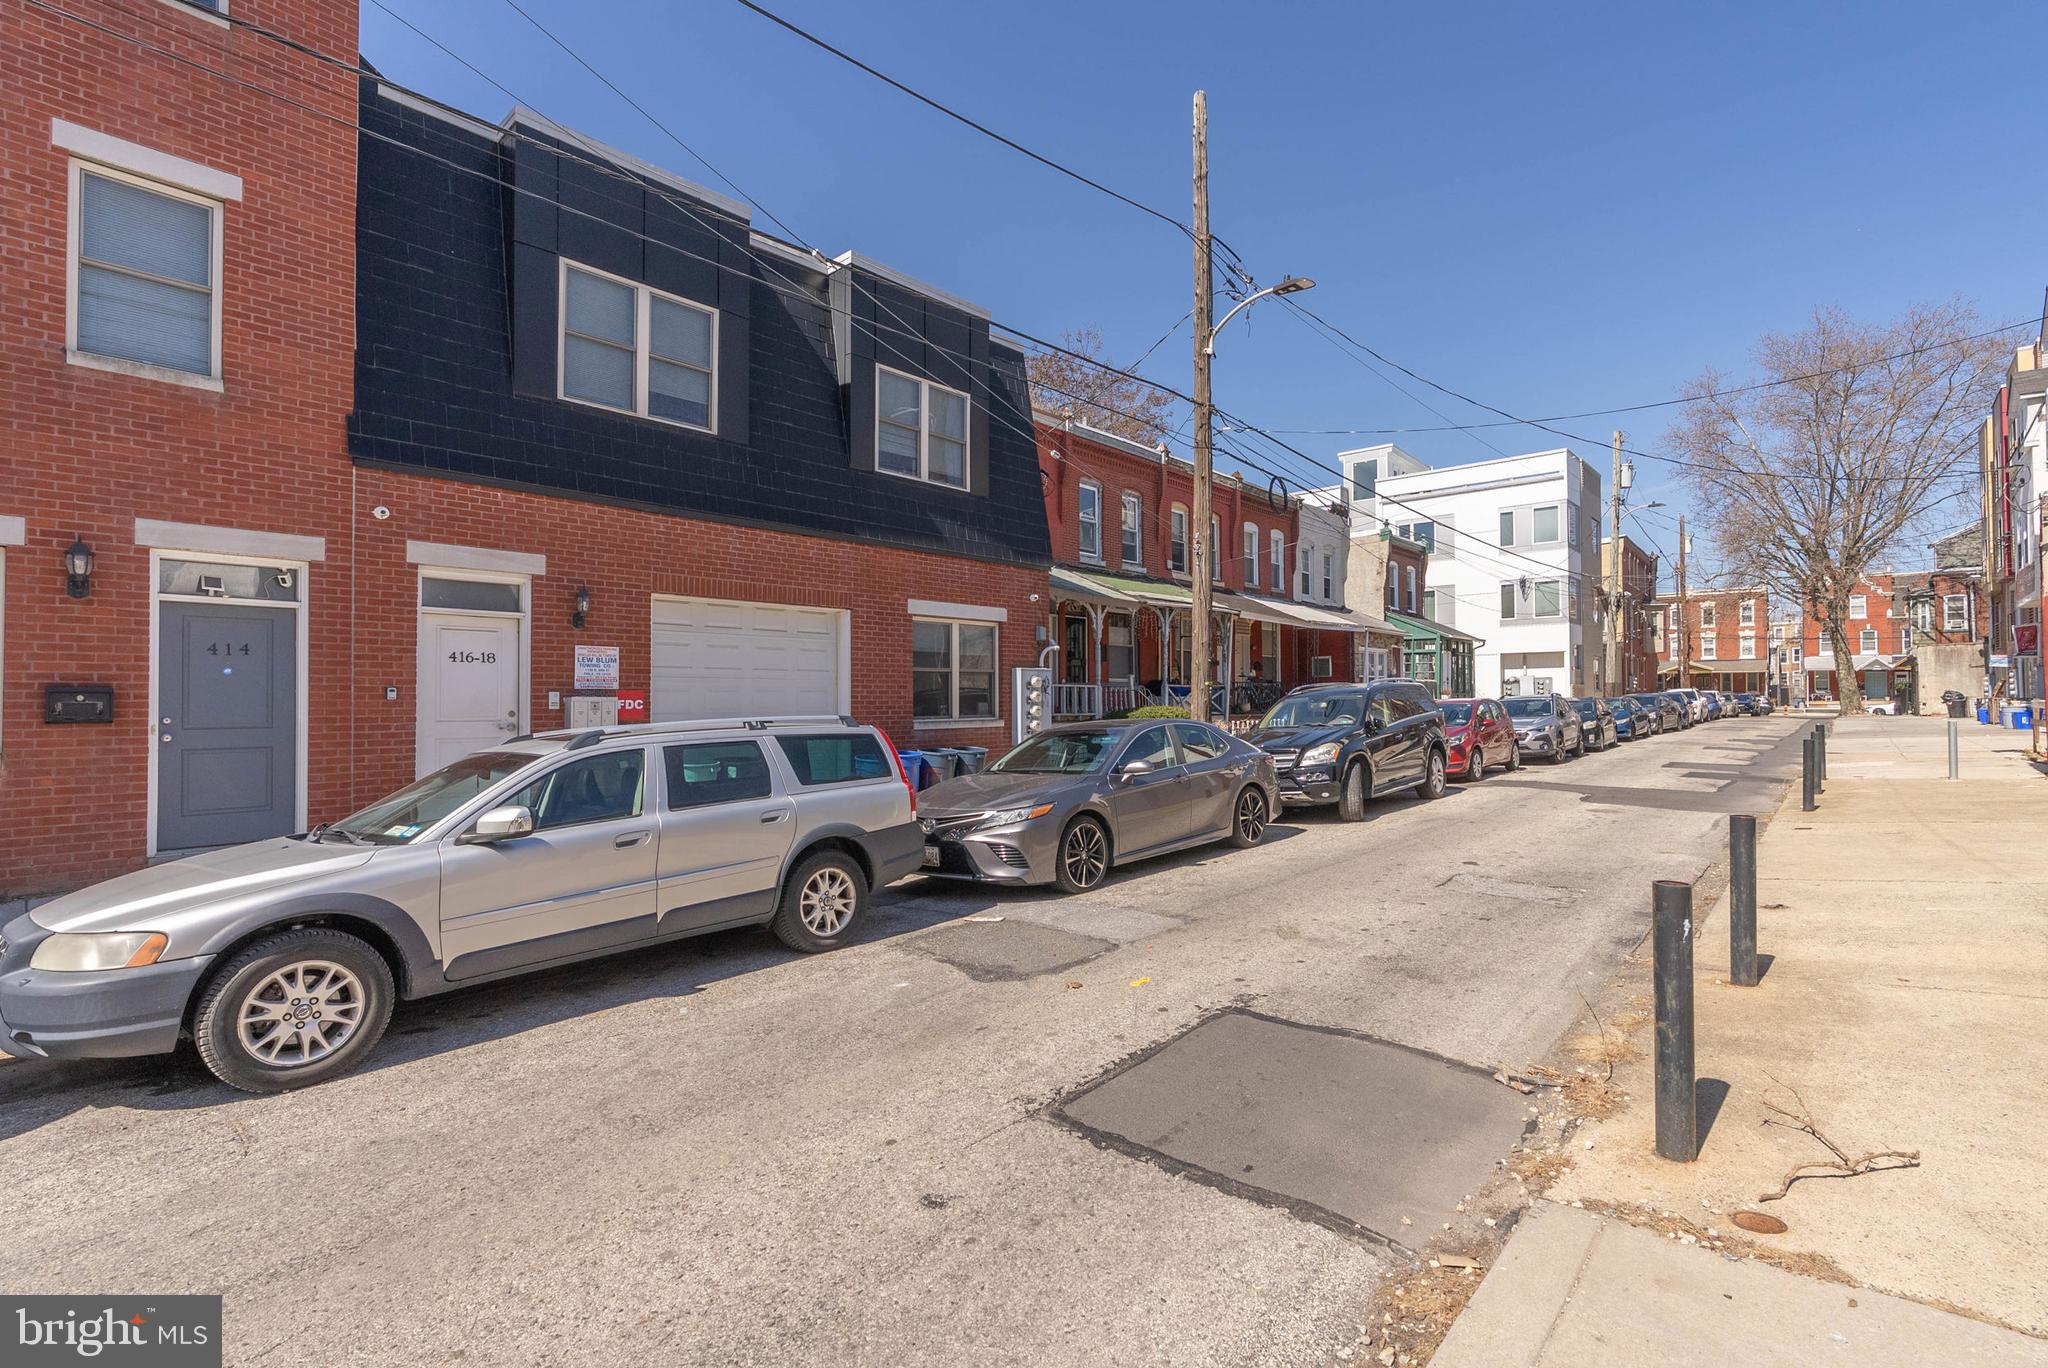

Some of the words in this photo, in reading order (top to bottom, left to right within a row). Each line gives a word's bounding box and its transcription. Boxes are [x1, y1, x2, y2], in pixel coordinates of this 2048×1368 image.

[207, 642, 250, 656] 414
[448, 651, 496, 664] 416-18
[617, 699, 644, 710] FDC
